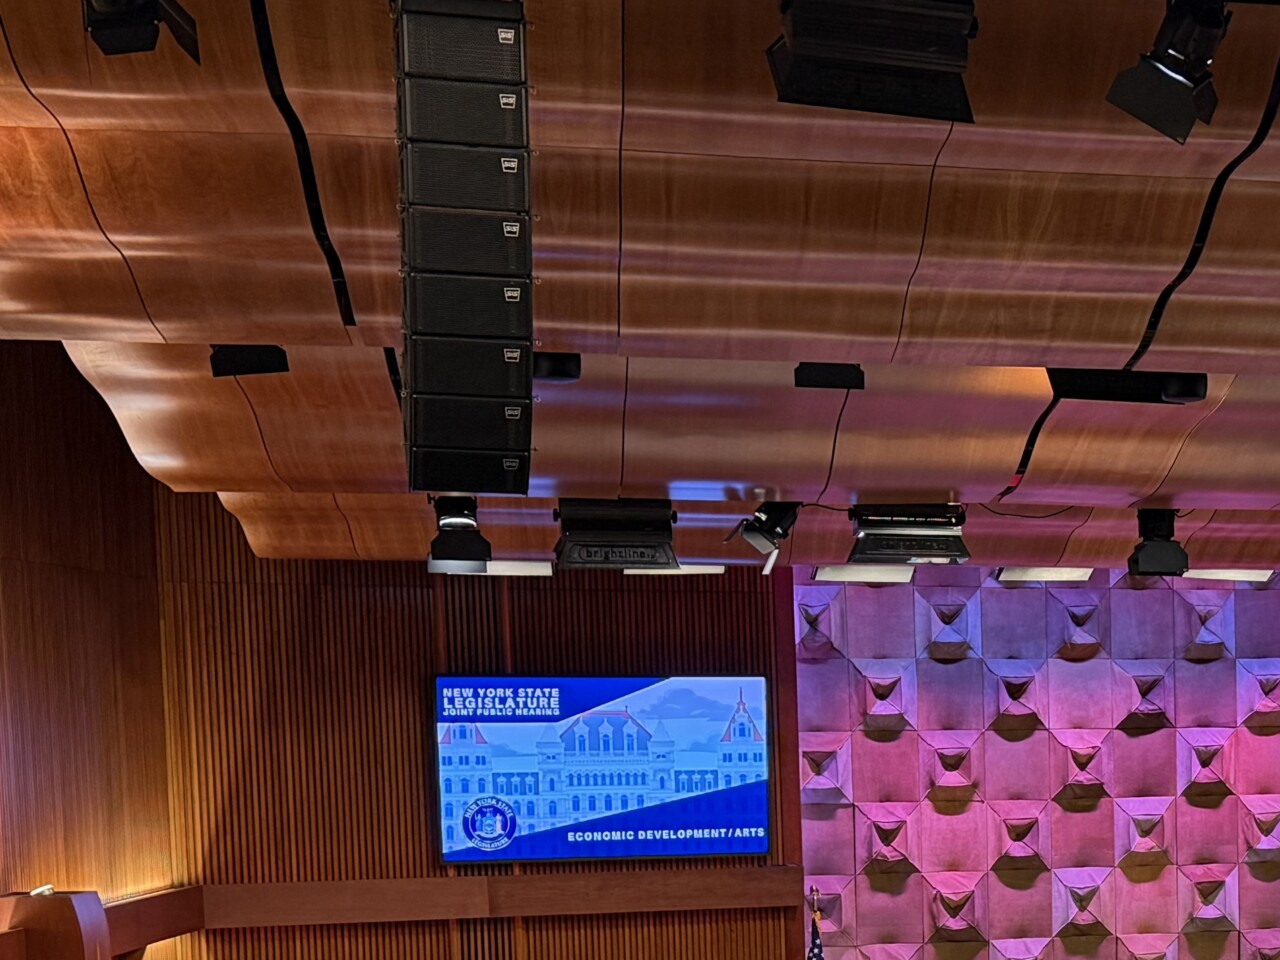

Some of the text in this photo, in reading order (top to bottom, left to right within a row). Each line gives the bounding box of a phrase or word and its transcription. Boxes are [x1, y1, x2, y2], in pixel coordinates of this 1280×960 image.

[443, 688, 559, 697] NEW YORK STATE
[444, 698, 560, 708] LEGISLATURE
[568, 831, 634, 841] ECONOMIC
